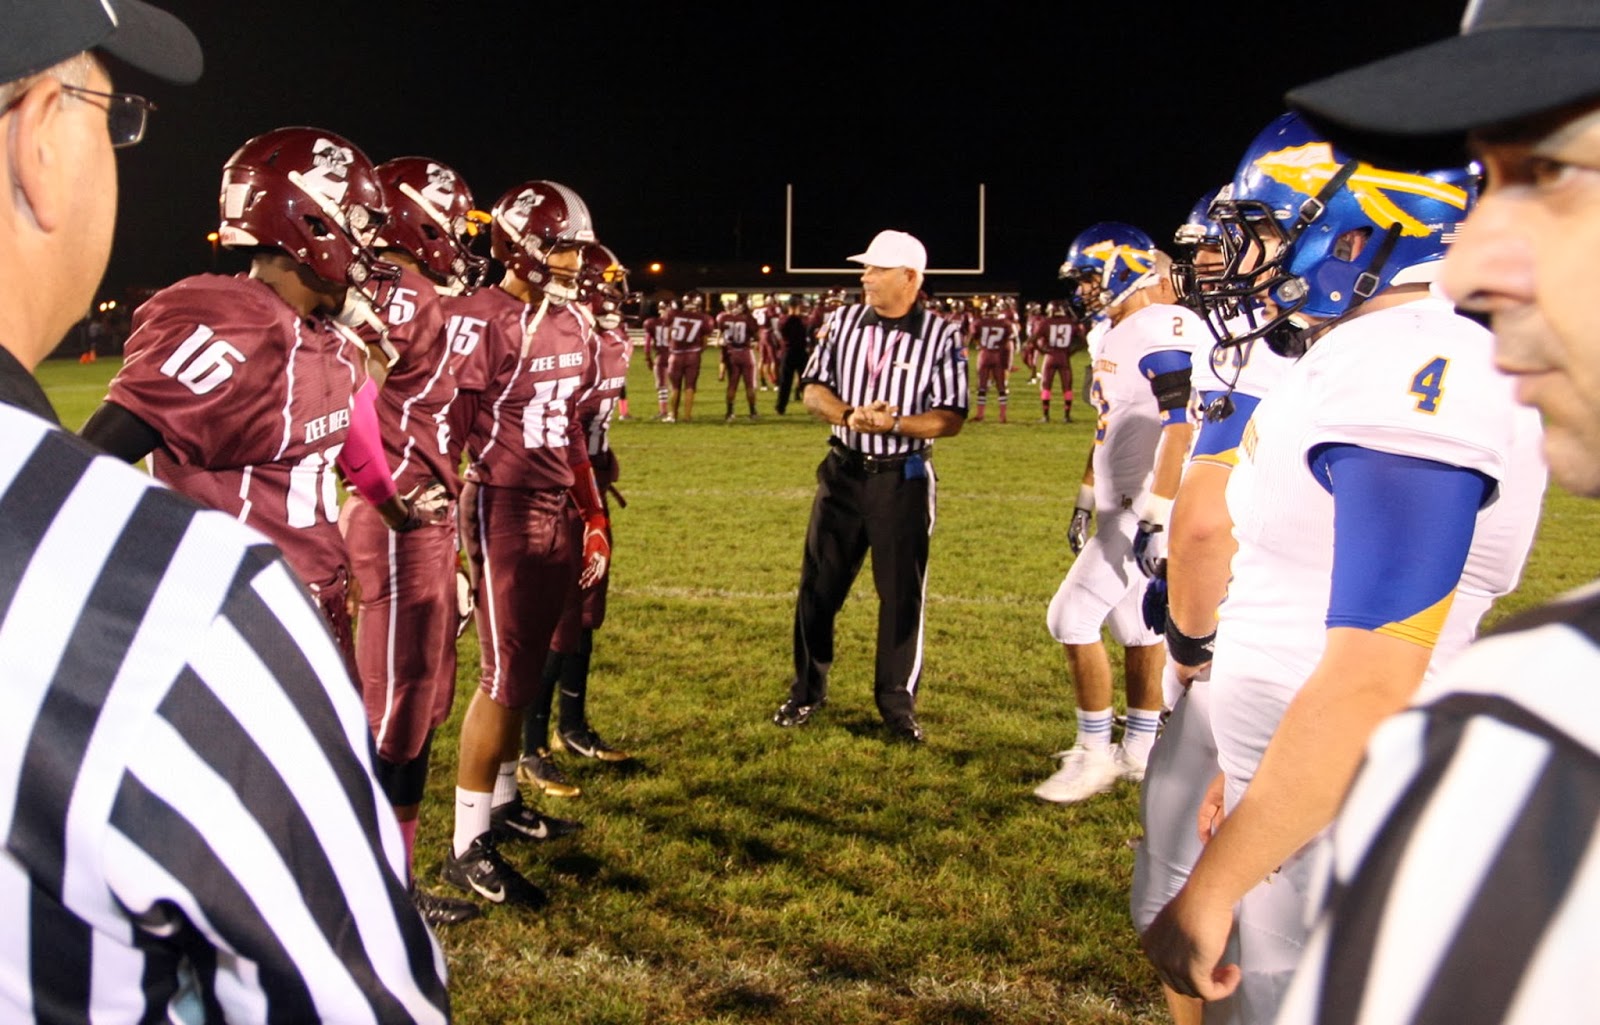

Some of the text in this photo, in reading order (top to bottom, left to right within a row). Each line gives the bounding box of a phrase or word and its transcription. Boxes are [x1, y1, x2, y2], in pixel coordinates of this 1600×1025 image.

[671, 316, 702, 343] 57
[980, 326, 1005, 349] 12
[1048, 323, 1073, 348] 13
[1172, 316, 1183, 336] 2
[159, 324, 247, 395] 16
[528, 351, 583, 373] ZEE BEES
[1407, 354, 1451, 416] 4
[304, 415, 328, 445] ZEE
